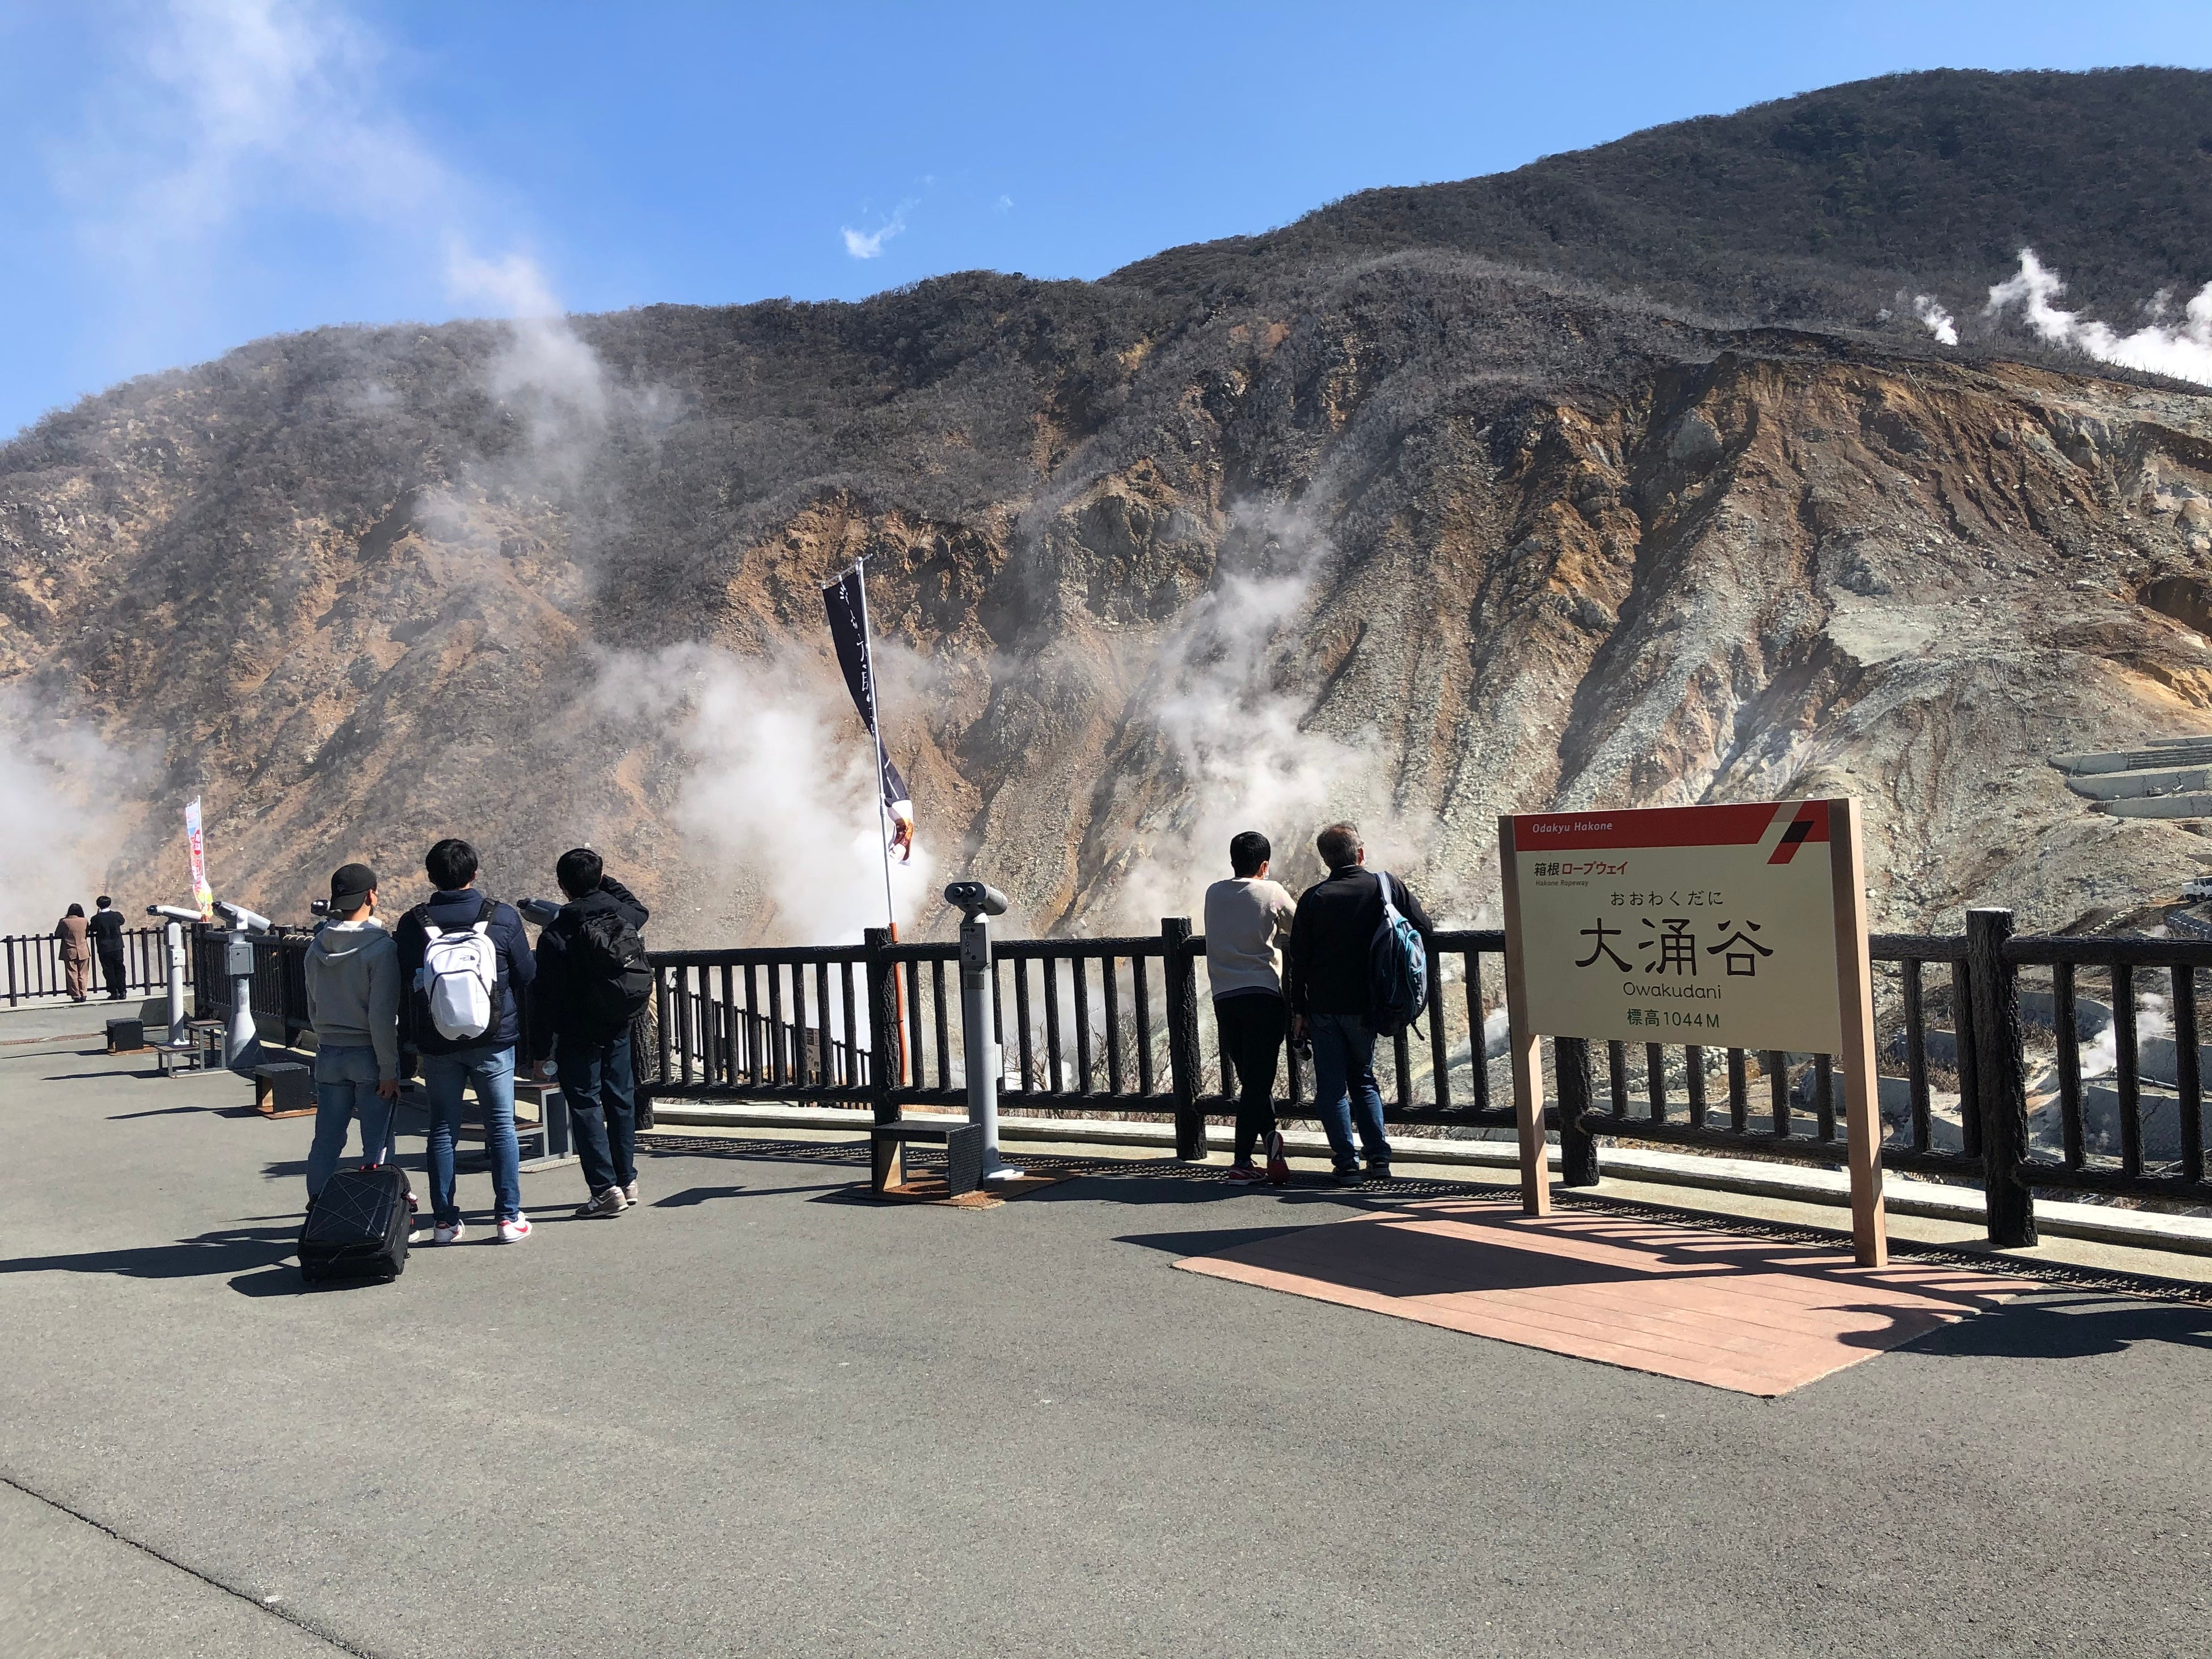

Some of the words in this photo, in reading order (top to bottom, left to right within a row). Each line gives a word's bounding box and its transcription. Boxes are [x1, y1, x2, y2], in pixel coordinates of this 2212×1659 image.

[1533, 823, 1570, 834] Odakyu
[1574, 821, 1612, 831] Hakone
[1534, 860, 1628, 876] 箱根ロープウェイ
[1610, 890, 1724, 906] おおわくだに
[1575, 917, 1774, 977] 大涌谷
[1623, 982, 1721, 999] Owakudani
[1627, 1008, 1720, 1028] 標高1044M
